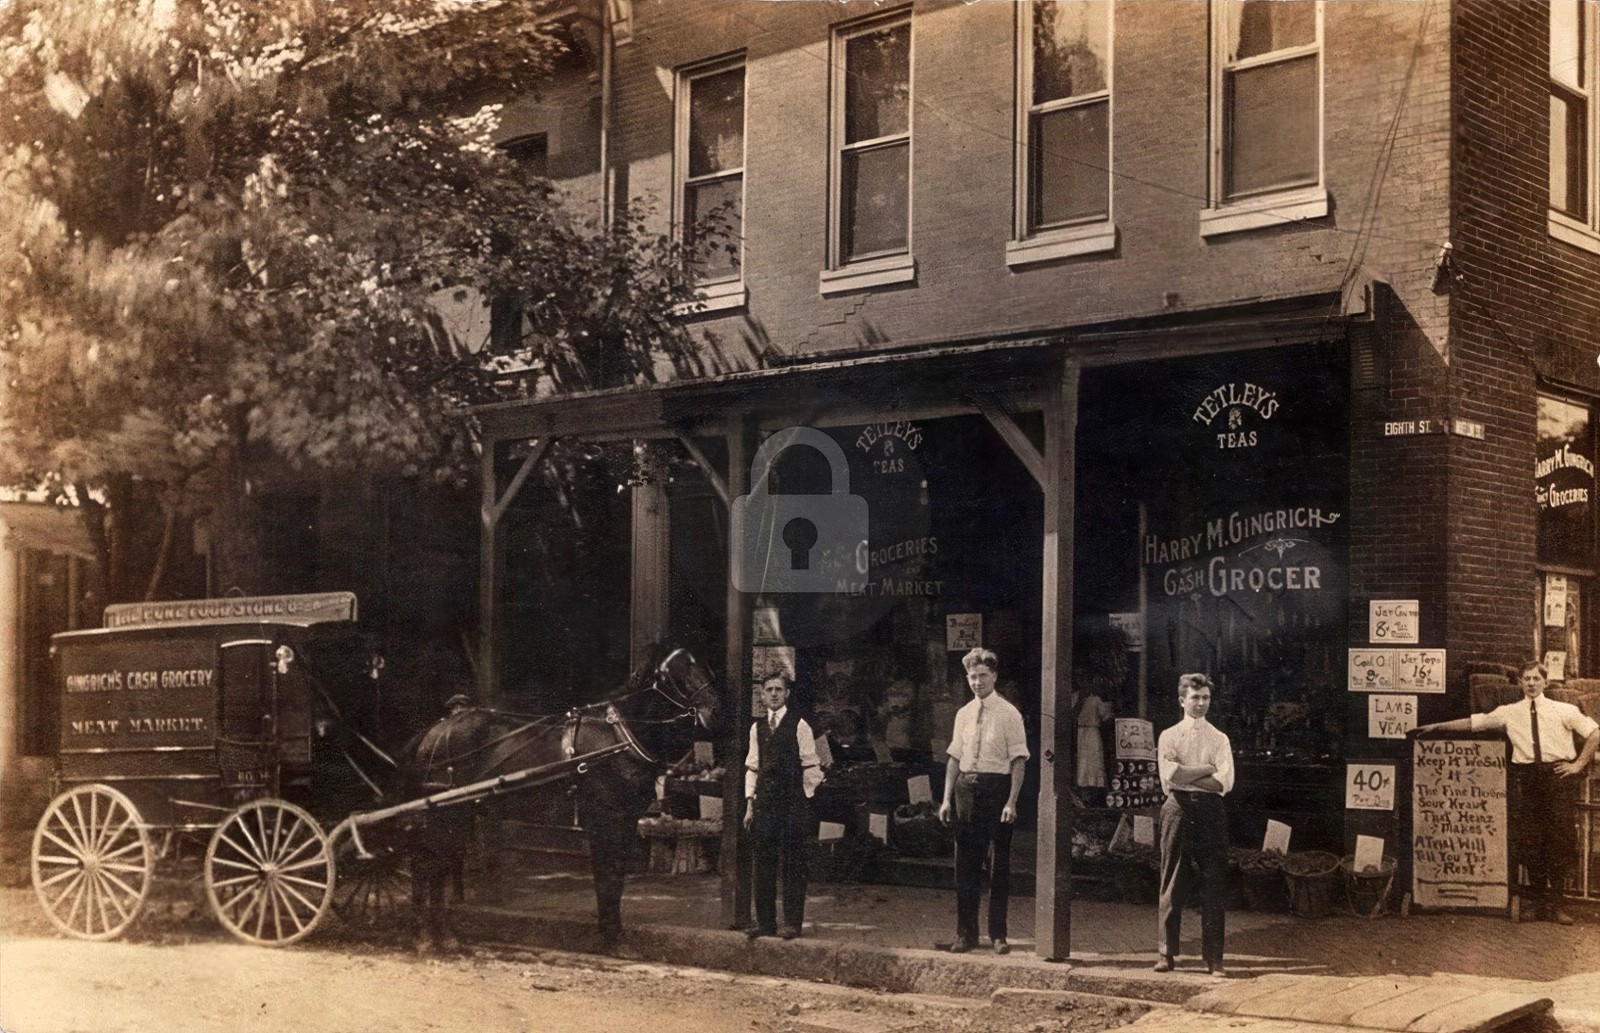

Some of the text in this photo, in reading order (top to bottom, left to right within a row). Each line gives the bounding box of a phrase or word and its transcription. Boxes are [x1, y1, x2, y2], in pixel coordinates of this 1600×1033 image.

[1193, 382, 1280, 425] TETLEY'S
[1384, 421, 1415, 436] EIGHTH
[1217, 431, 1257, 449] TEAS
[1144, 533, 1203, 565] HARRY
[1229, 507, 1324, 543] GINGRICH
[855, 537, 938, 575] GROCERIES
[1208, 556, 1321, 597] GROCER
[880, 577, 943, 596] MARKET
[127, 671, 158, 690] CASH
[161, 669, 213, 688] GROCERY
[1375, 699, 1413, 715] LAMB
[72, 720, 119, 734] MEAT
[1418, 742, 1442, 755] We
[1417, 755, 1446, 770] Keep
[1416, 784, 1438, 796] The
[1442, 785, 1468, 797] Fine
[1418, 797, 1488, 811] Sour Kraut
[1457, 837, 1486, 853] Will
[1439, 851, 1460, 862] You
